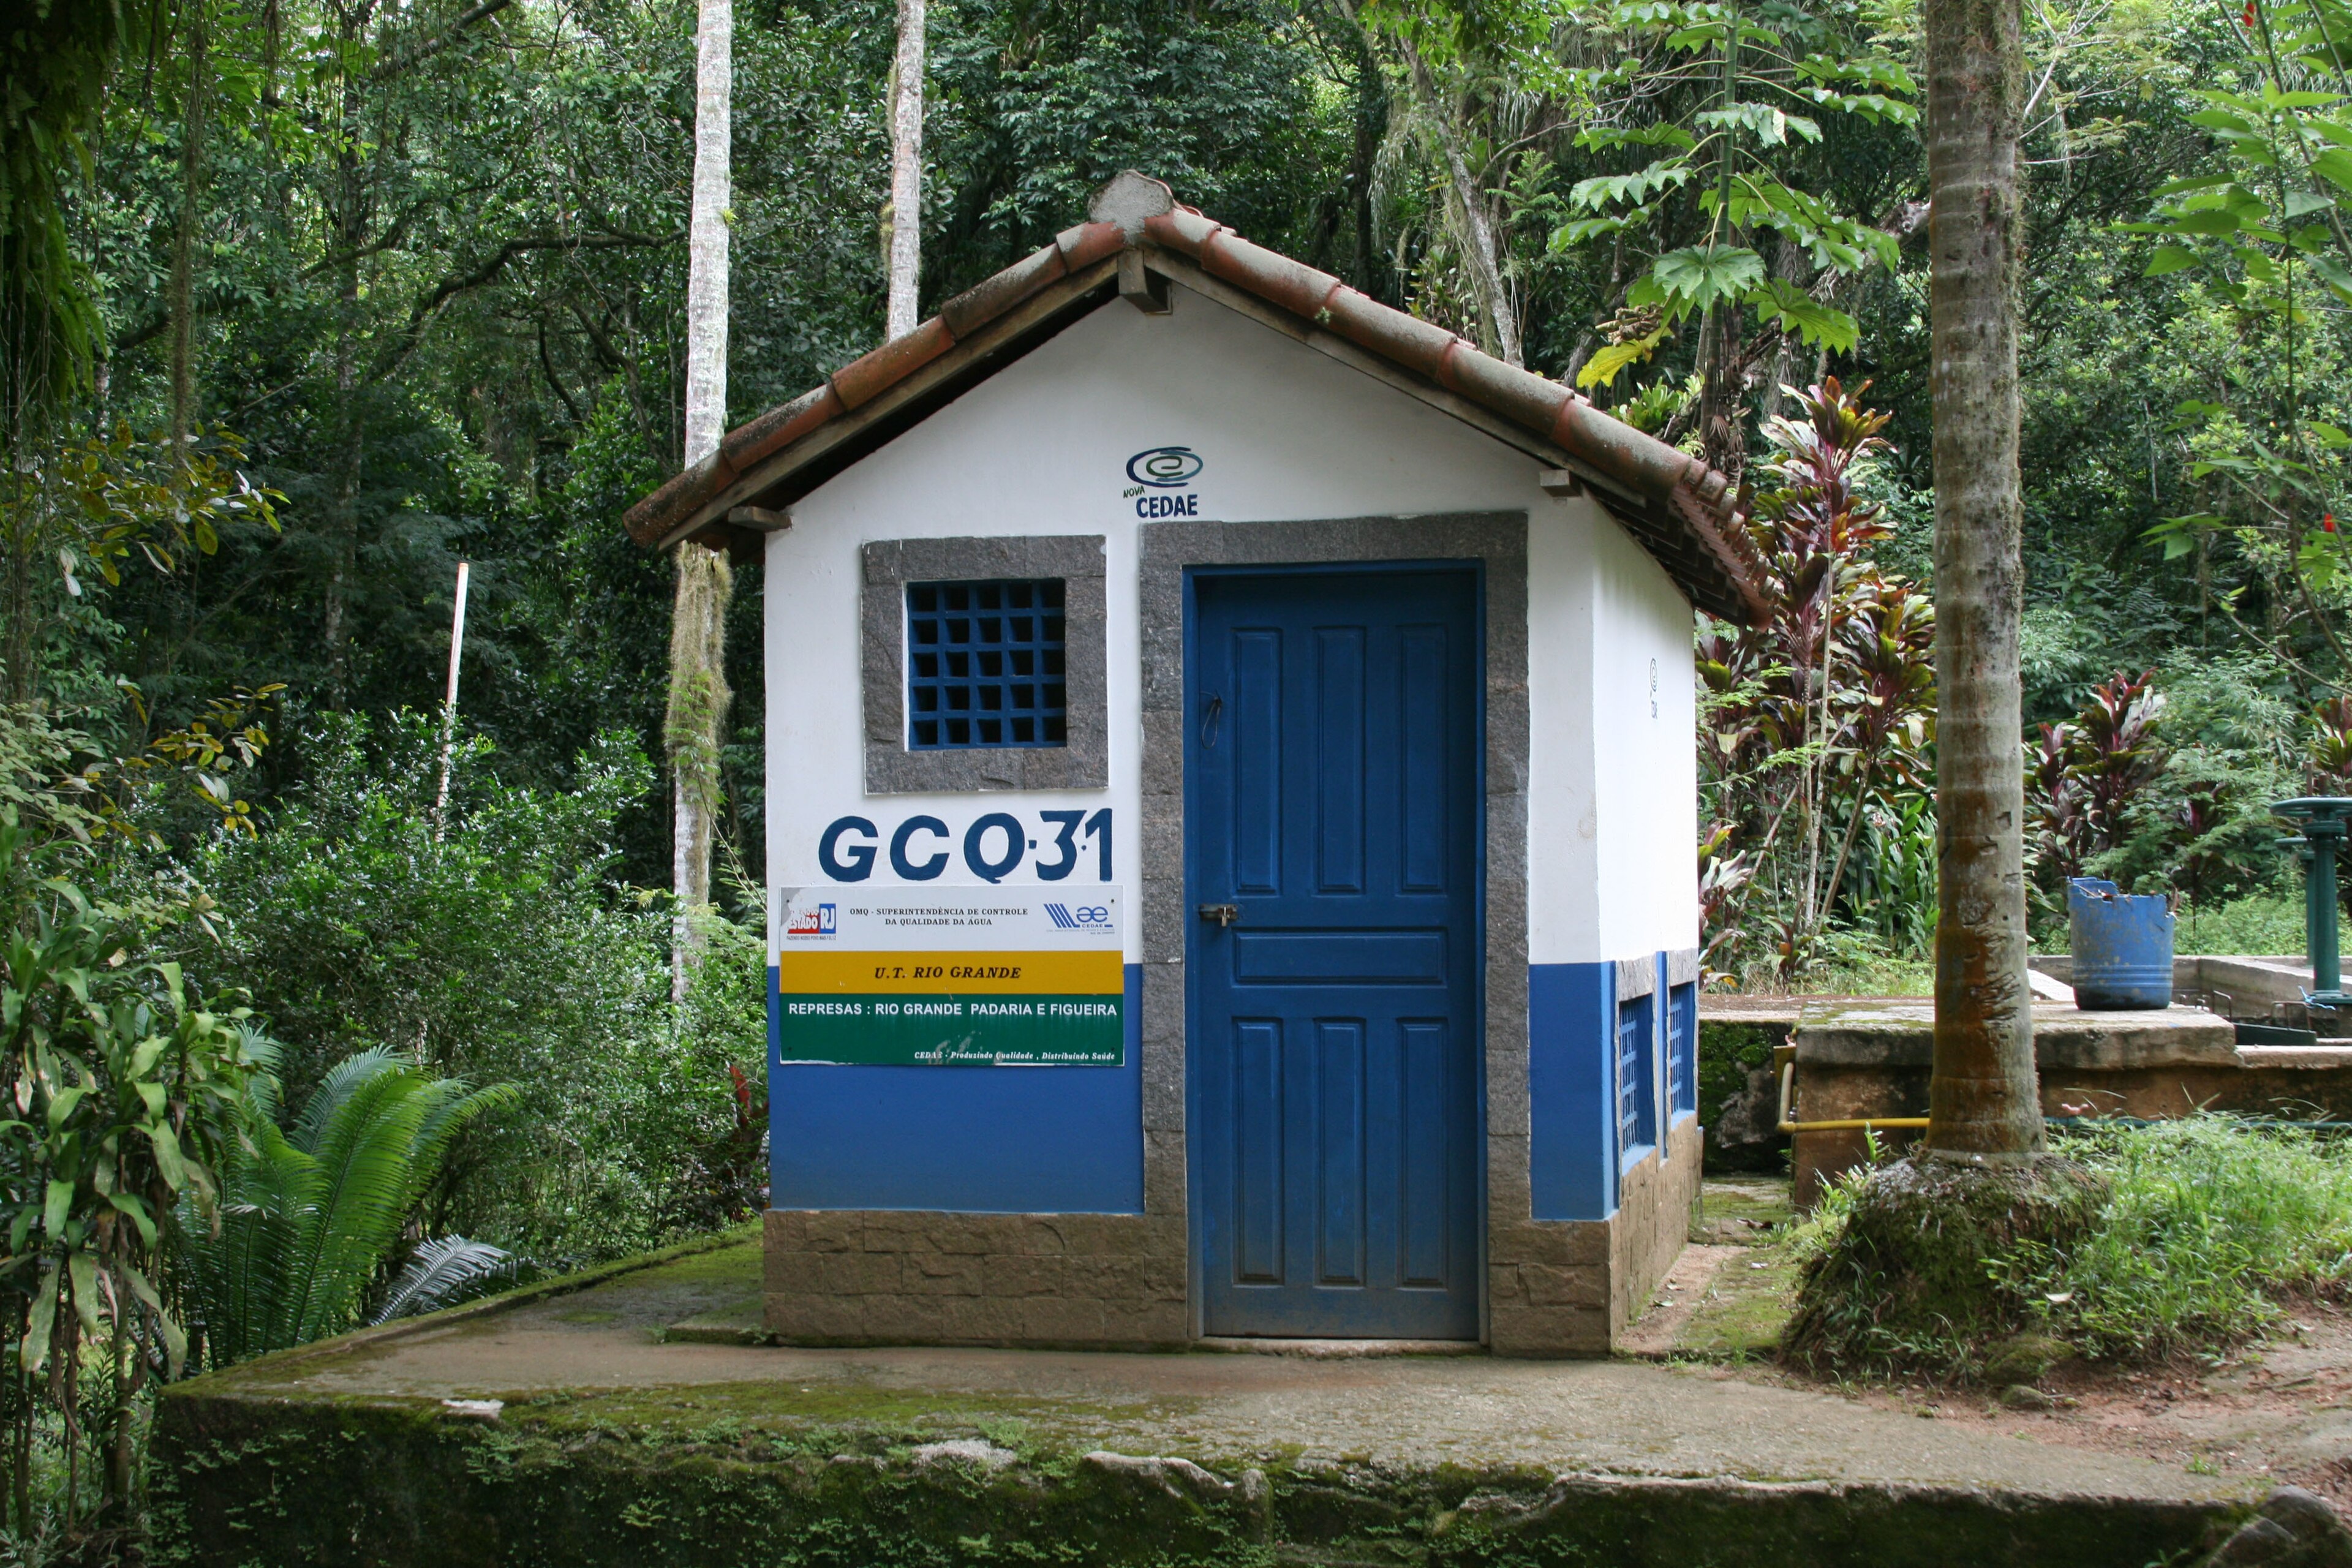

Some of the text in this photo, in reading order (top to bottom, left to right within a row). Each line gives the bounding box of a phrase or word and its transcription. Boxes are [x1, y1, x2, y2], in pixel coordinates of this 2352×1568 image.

[1123, 485, 1145, 499] NOVA
[1136, 494, 1198, 518] CEDAE
[876, 906, 965, 916] SUPERINTENDÊNCIA
[820, 907, 835, 930] RJ
[900, 918, 950, 927] QUALIDADE
[968, 916, 993, 925] ÁGUA
[875, 966, 1022, 979] U.T. RIO GRANDE
[788, 1003, 862, 1015] REPRESAS
[875, 1003, 899, 1015] RIO
[903, 1003, 962, 1015] GRANDE
[970, 1003, 1033, 1015] PADARIA
[1037, 1003, 1046, 1015] E
[1050, 1003, 1118, 1016] FIGUEIRA
[995, 1051, 1033, 1061] Qualidade
